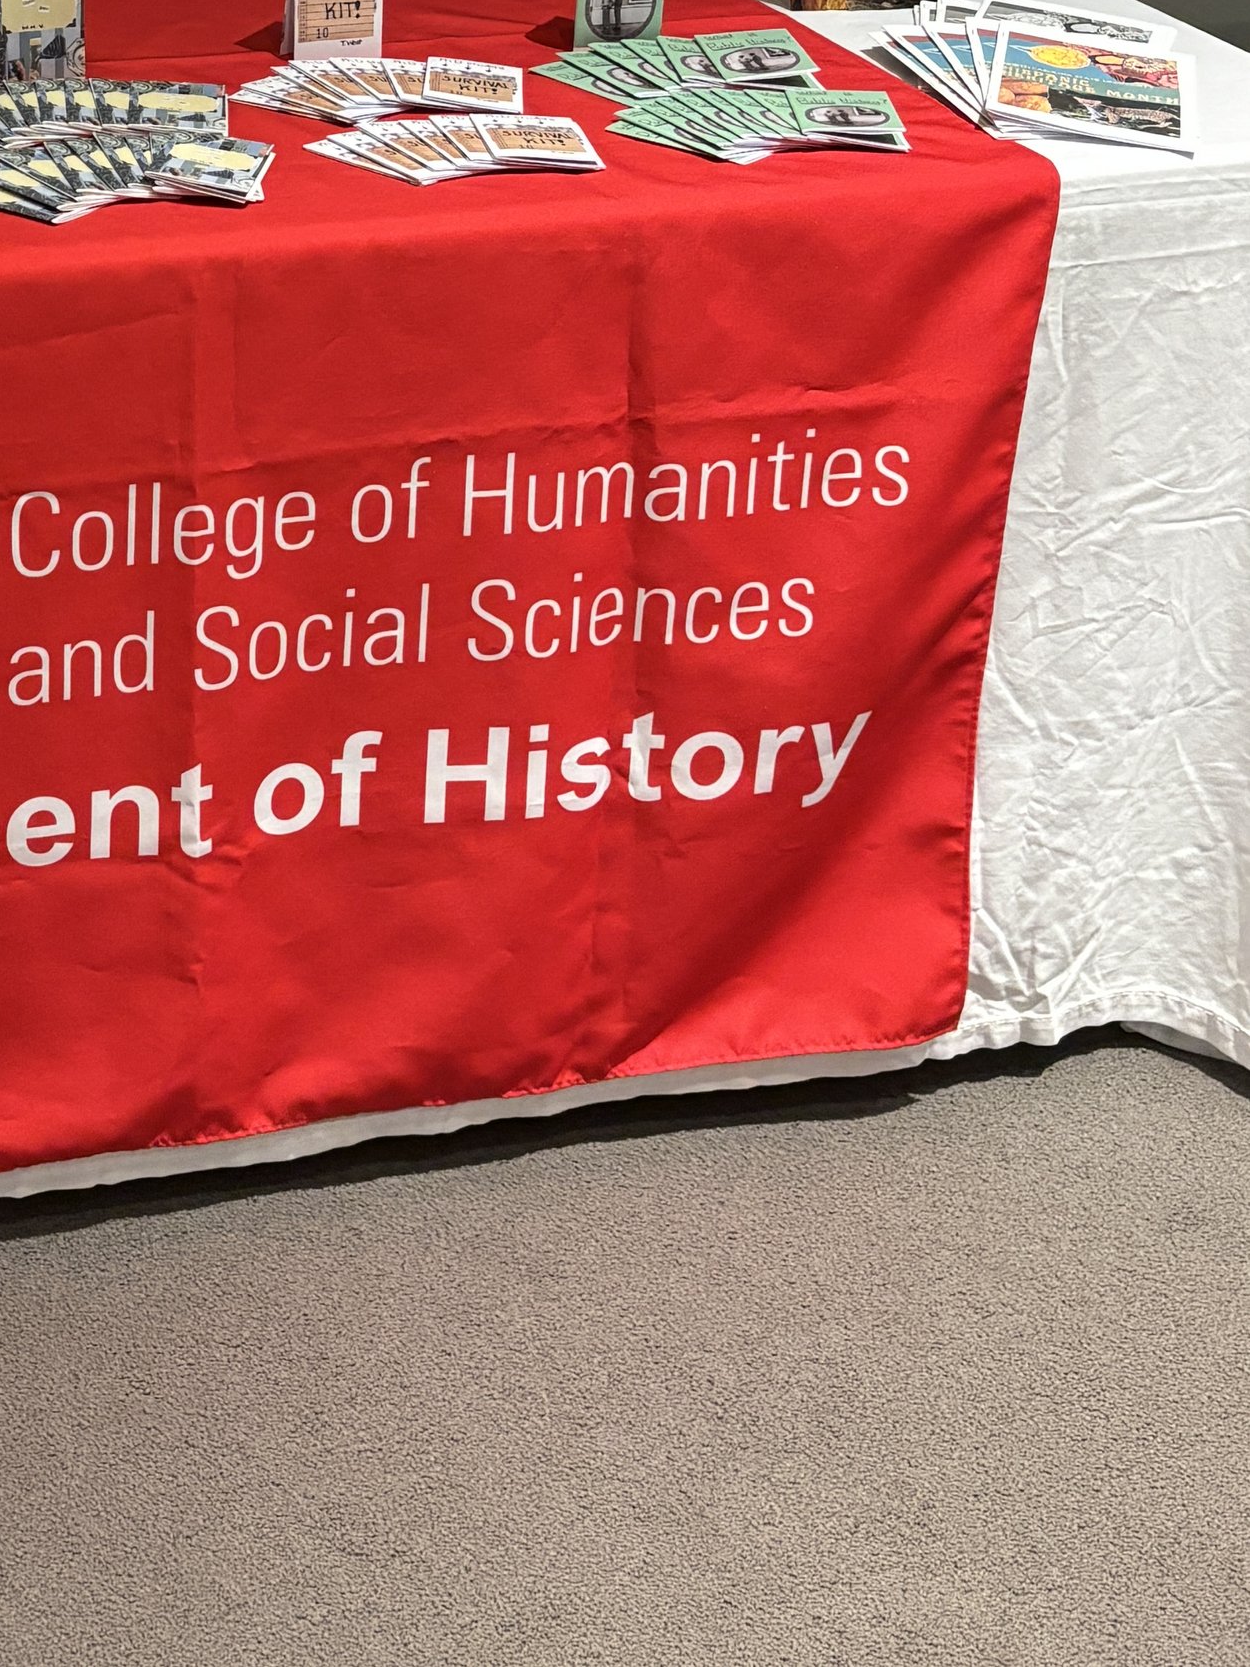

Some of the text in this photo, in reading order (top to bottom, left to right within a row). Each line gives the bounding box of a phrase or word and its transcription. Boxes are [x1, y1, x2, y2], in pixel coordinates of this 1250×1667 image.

[325, 0, 360, 20] KIT!
[316, 27, 329, 39] 10
[442, 75, 509, 89] SURVIVAL
[459, 84, 498, 95] KIT!
[502, 130, 572, 139] SURVIVAL
[523, 137, 566, 146] KIT!
[12, 429, 909, 579] College of Humanities
[9, 578, 814, 705] and Social Sciences
[254, 731, 382, 835] of
[424, 712, 871, 823] History
